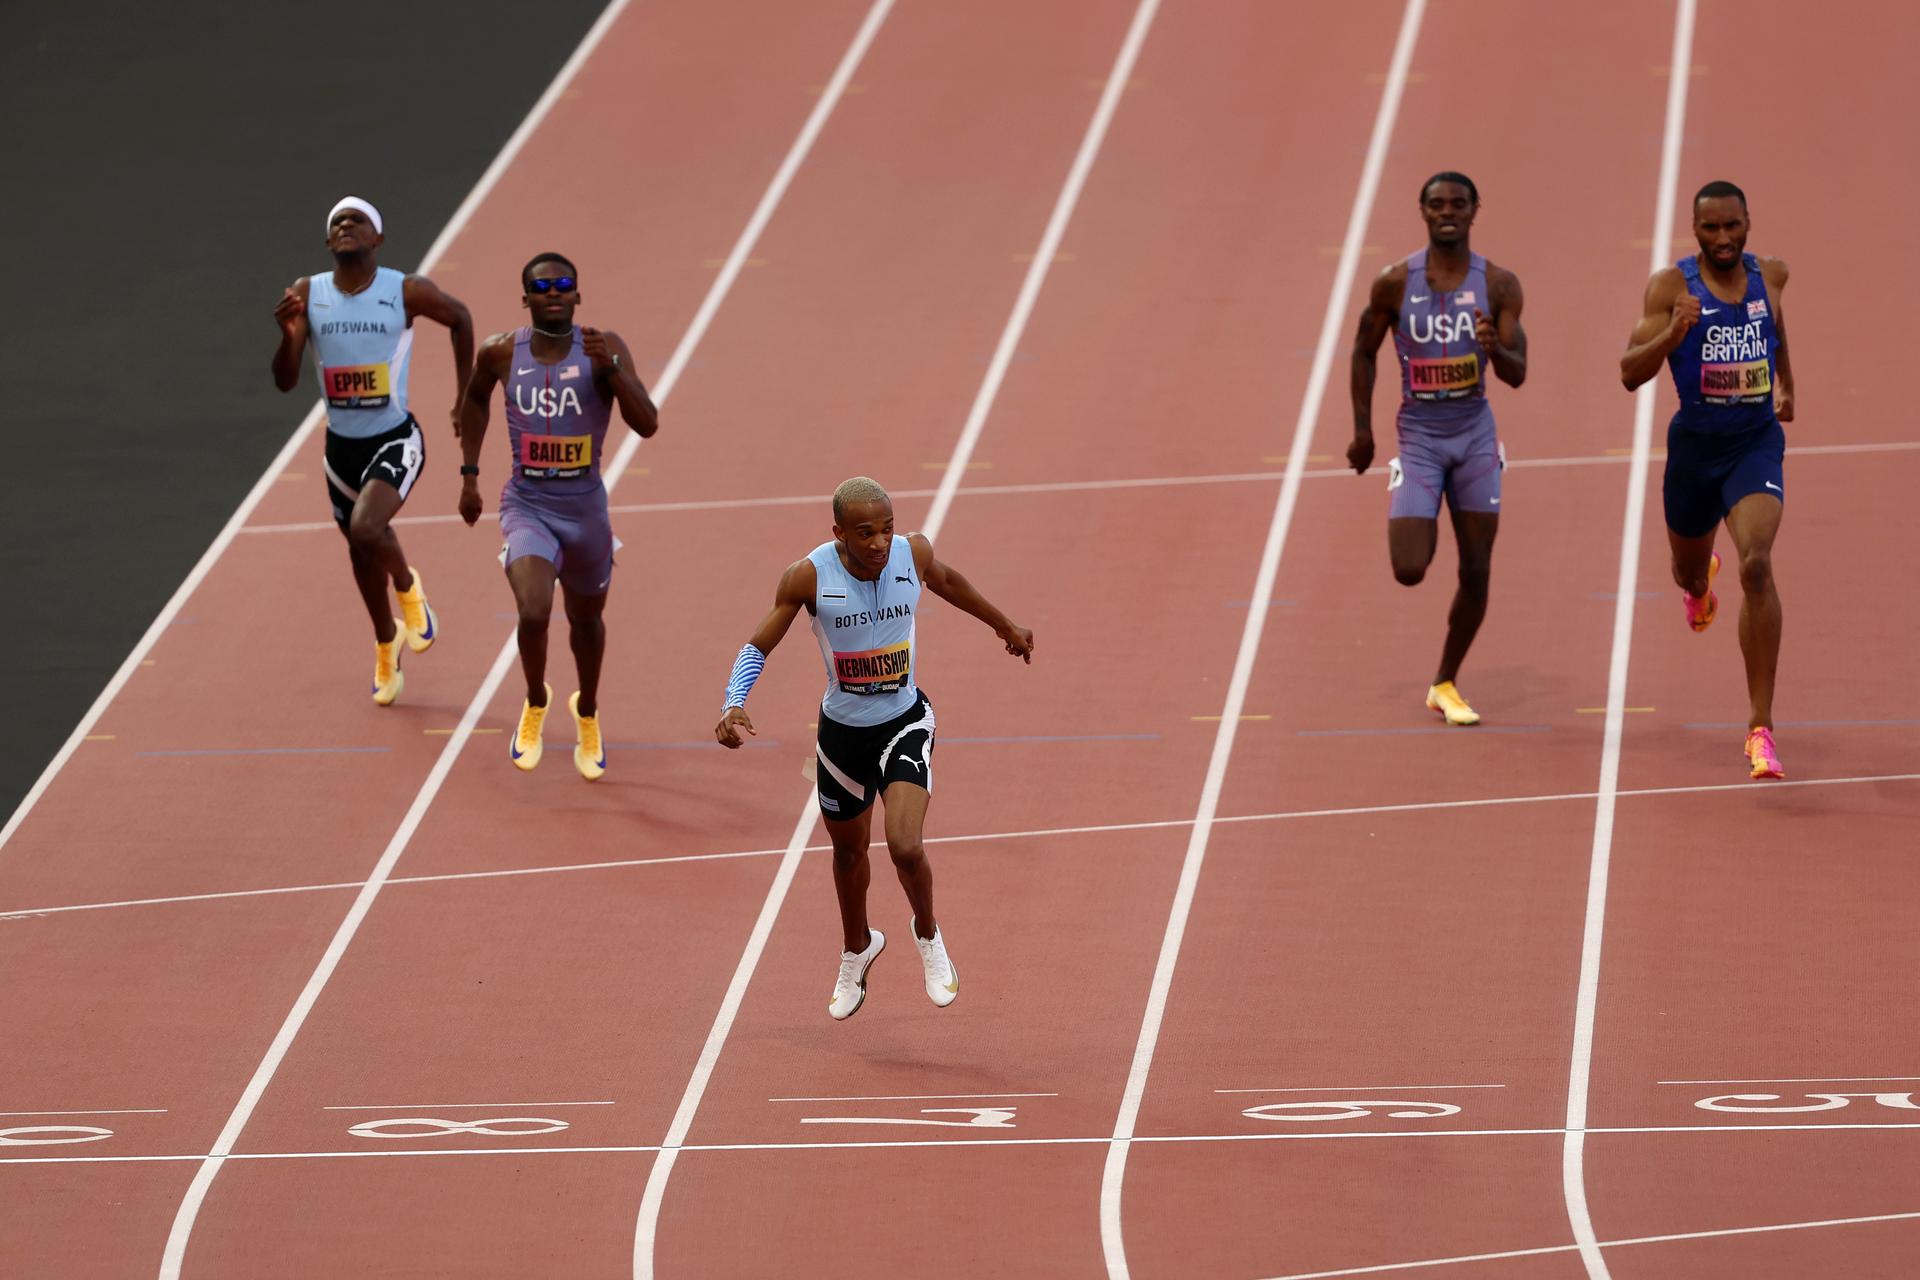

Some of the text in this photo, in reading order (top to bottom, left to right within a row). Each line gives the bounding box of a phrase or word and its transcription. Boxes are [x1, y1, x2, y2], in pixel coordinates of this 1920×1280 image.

[320, 321, 387, 336] BOTSWANA
[1409, 311, 1476, 344] USA
[1706, 320, 1763, 345] GREAT
[1702, 338, 1767, 362] BRITAIN
[333, 370, 377, 393] EPPIE
[515, 384, 583, 418] USA
[529, 441, 584, 463] BAILEY
[835, 603, 911, 629] BOTSWANA
[837, 648, 909, 678] KEBINATSHIPI
[1241, 1100, 1462, 1121] 6
[347, 1117, 570, 1138] 8
